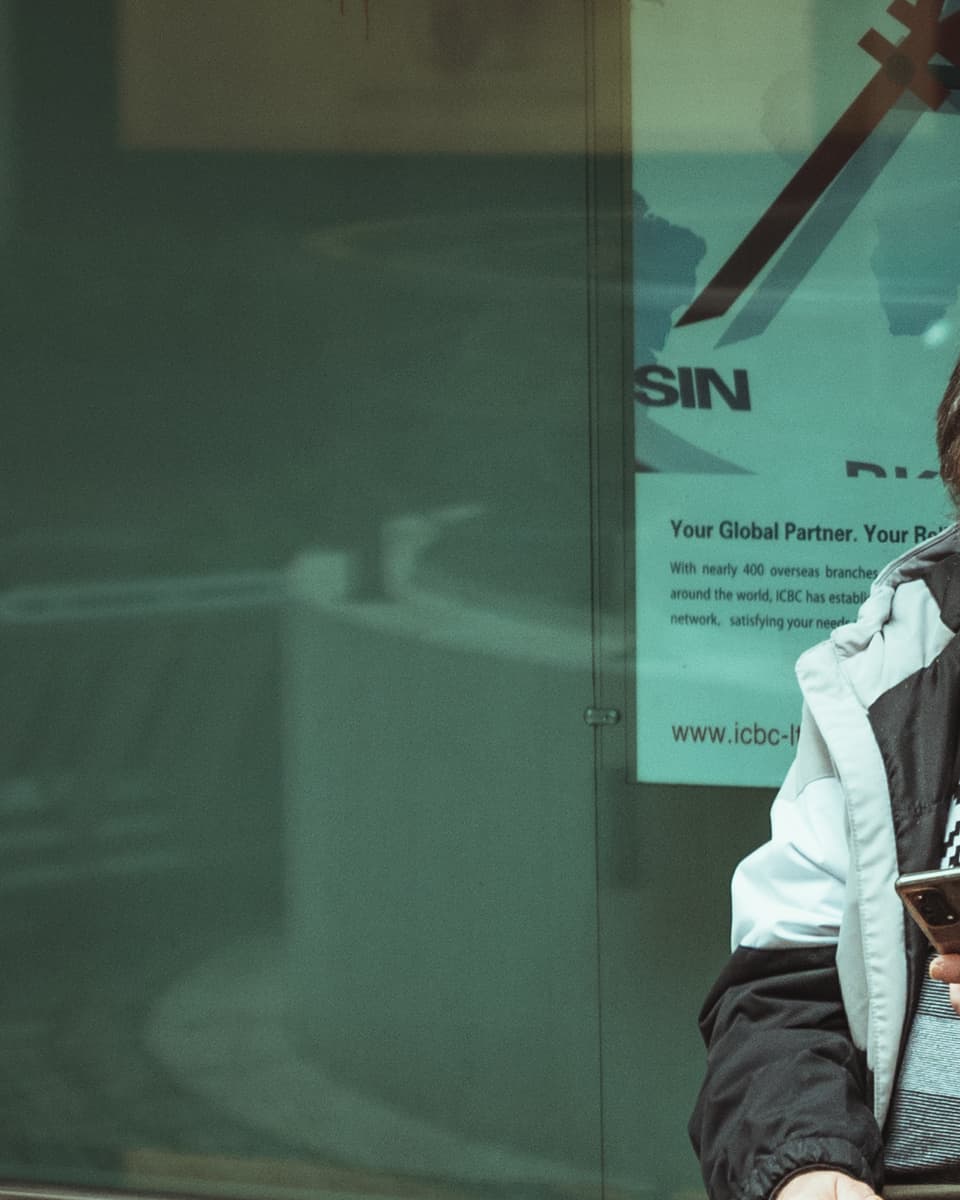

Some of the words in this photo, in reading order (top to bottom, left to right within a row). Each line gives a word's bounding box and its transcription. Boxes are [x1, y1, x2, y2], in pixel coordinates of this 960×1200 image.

[670, 519, 713, 540] Your
[719, 520, 779, 541] Global
[784, 521, 858, 543] Partner.
[863, 524, 909, 544] Your
[669, 561, 697, 575] With
[702, 563, 738, 578] nearly
[743, 563, 765, 577] 400
[770, 566, 820, 578] overseas
[825, 565, 879, 580] branches
[670, 587, 711, 601] around
[714, 587, 734, 601] the
[736, 588, 773, 603] world,
[776, 589, 803, 603] ICBC
[806, 591, 826, 604] has
[828, 592, 870, 605] establi
[729, 614, 785, 631] satisfying
[787, 618, 814, 630] your
[816, 617, 850, 630] need
